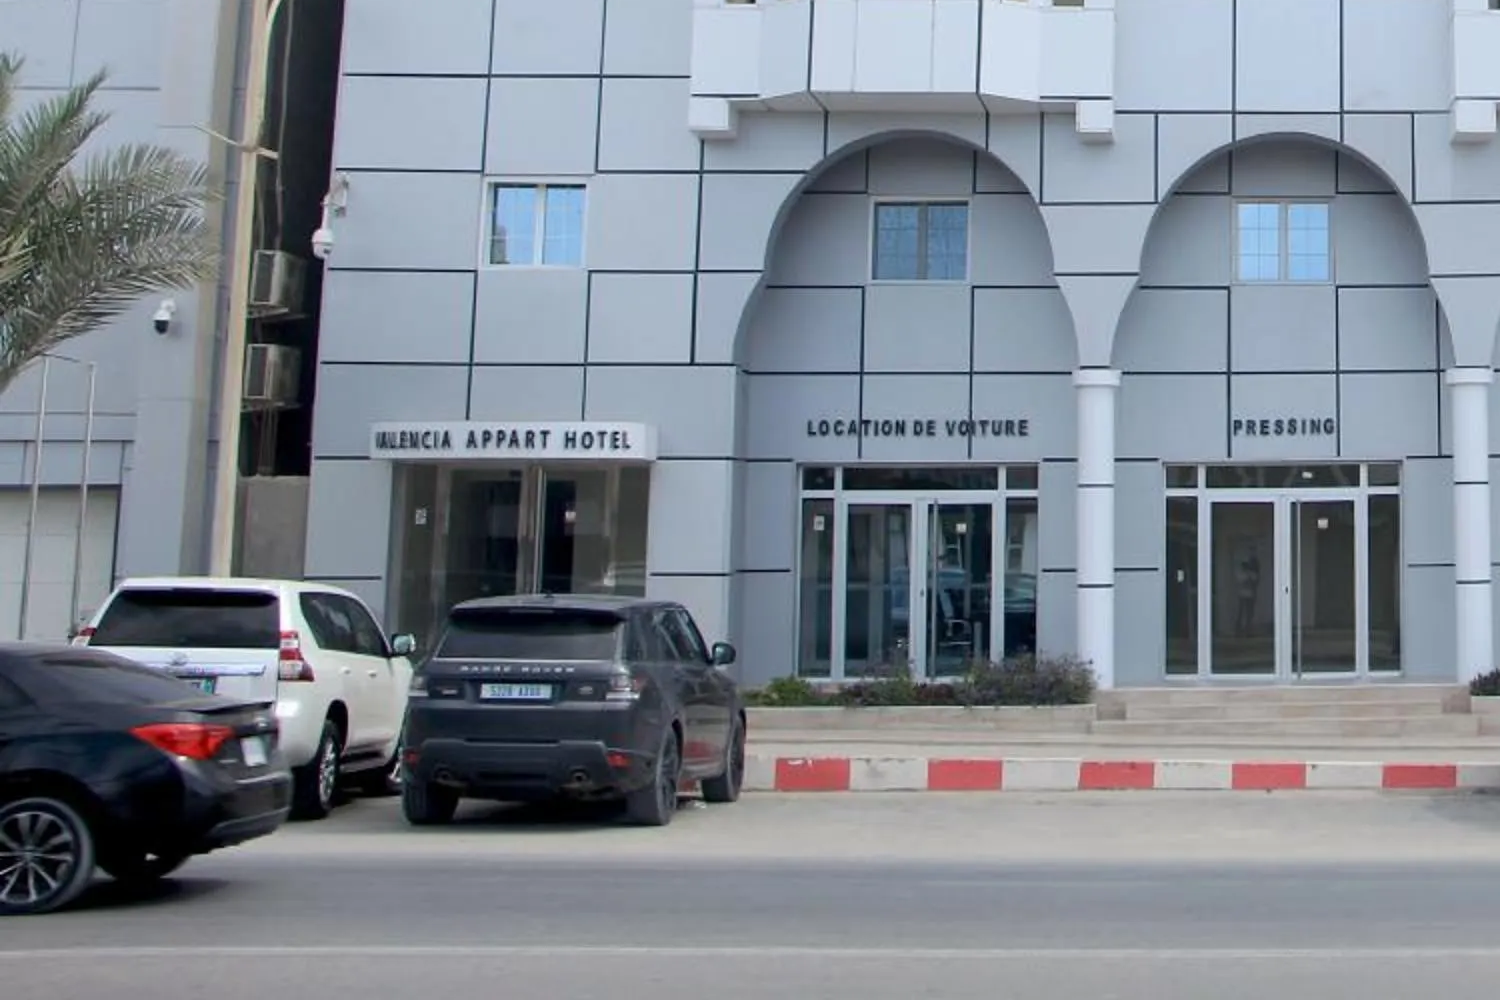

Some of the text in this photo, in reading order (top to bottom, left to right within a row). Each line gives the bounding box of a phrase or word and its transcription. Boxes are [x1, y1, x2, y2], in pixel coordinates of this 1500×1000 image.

[806, 418, 1030, 437] LOCATION DE VOITURE
[1232, 417, 1335, 436] PRESSING
[465, 429, 552, 450] APPART
[563, 429, 632, 450] HOTEL
